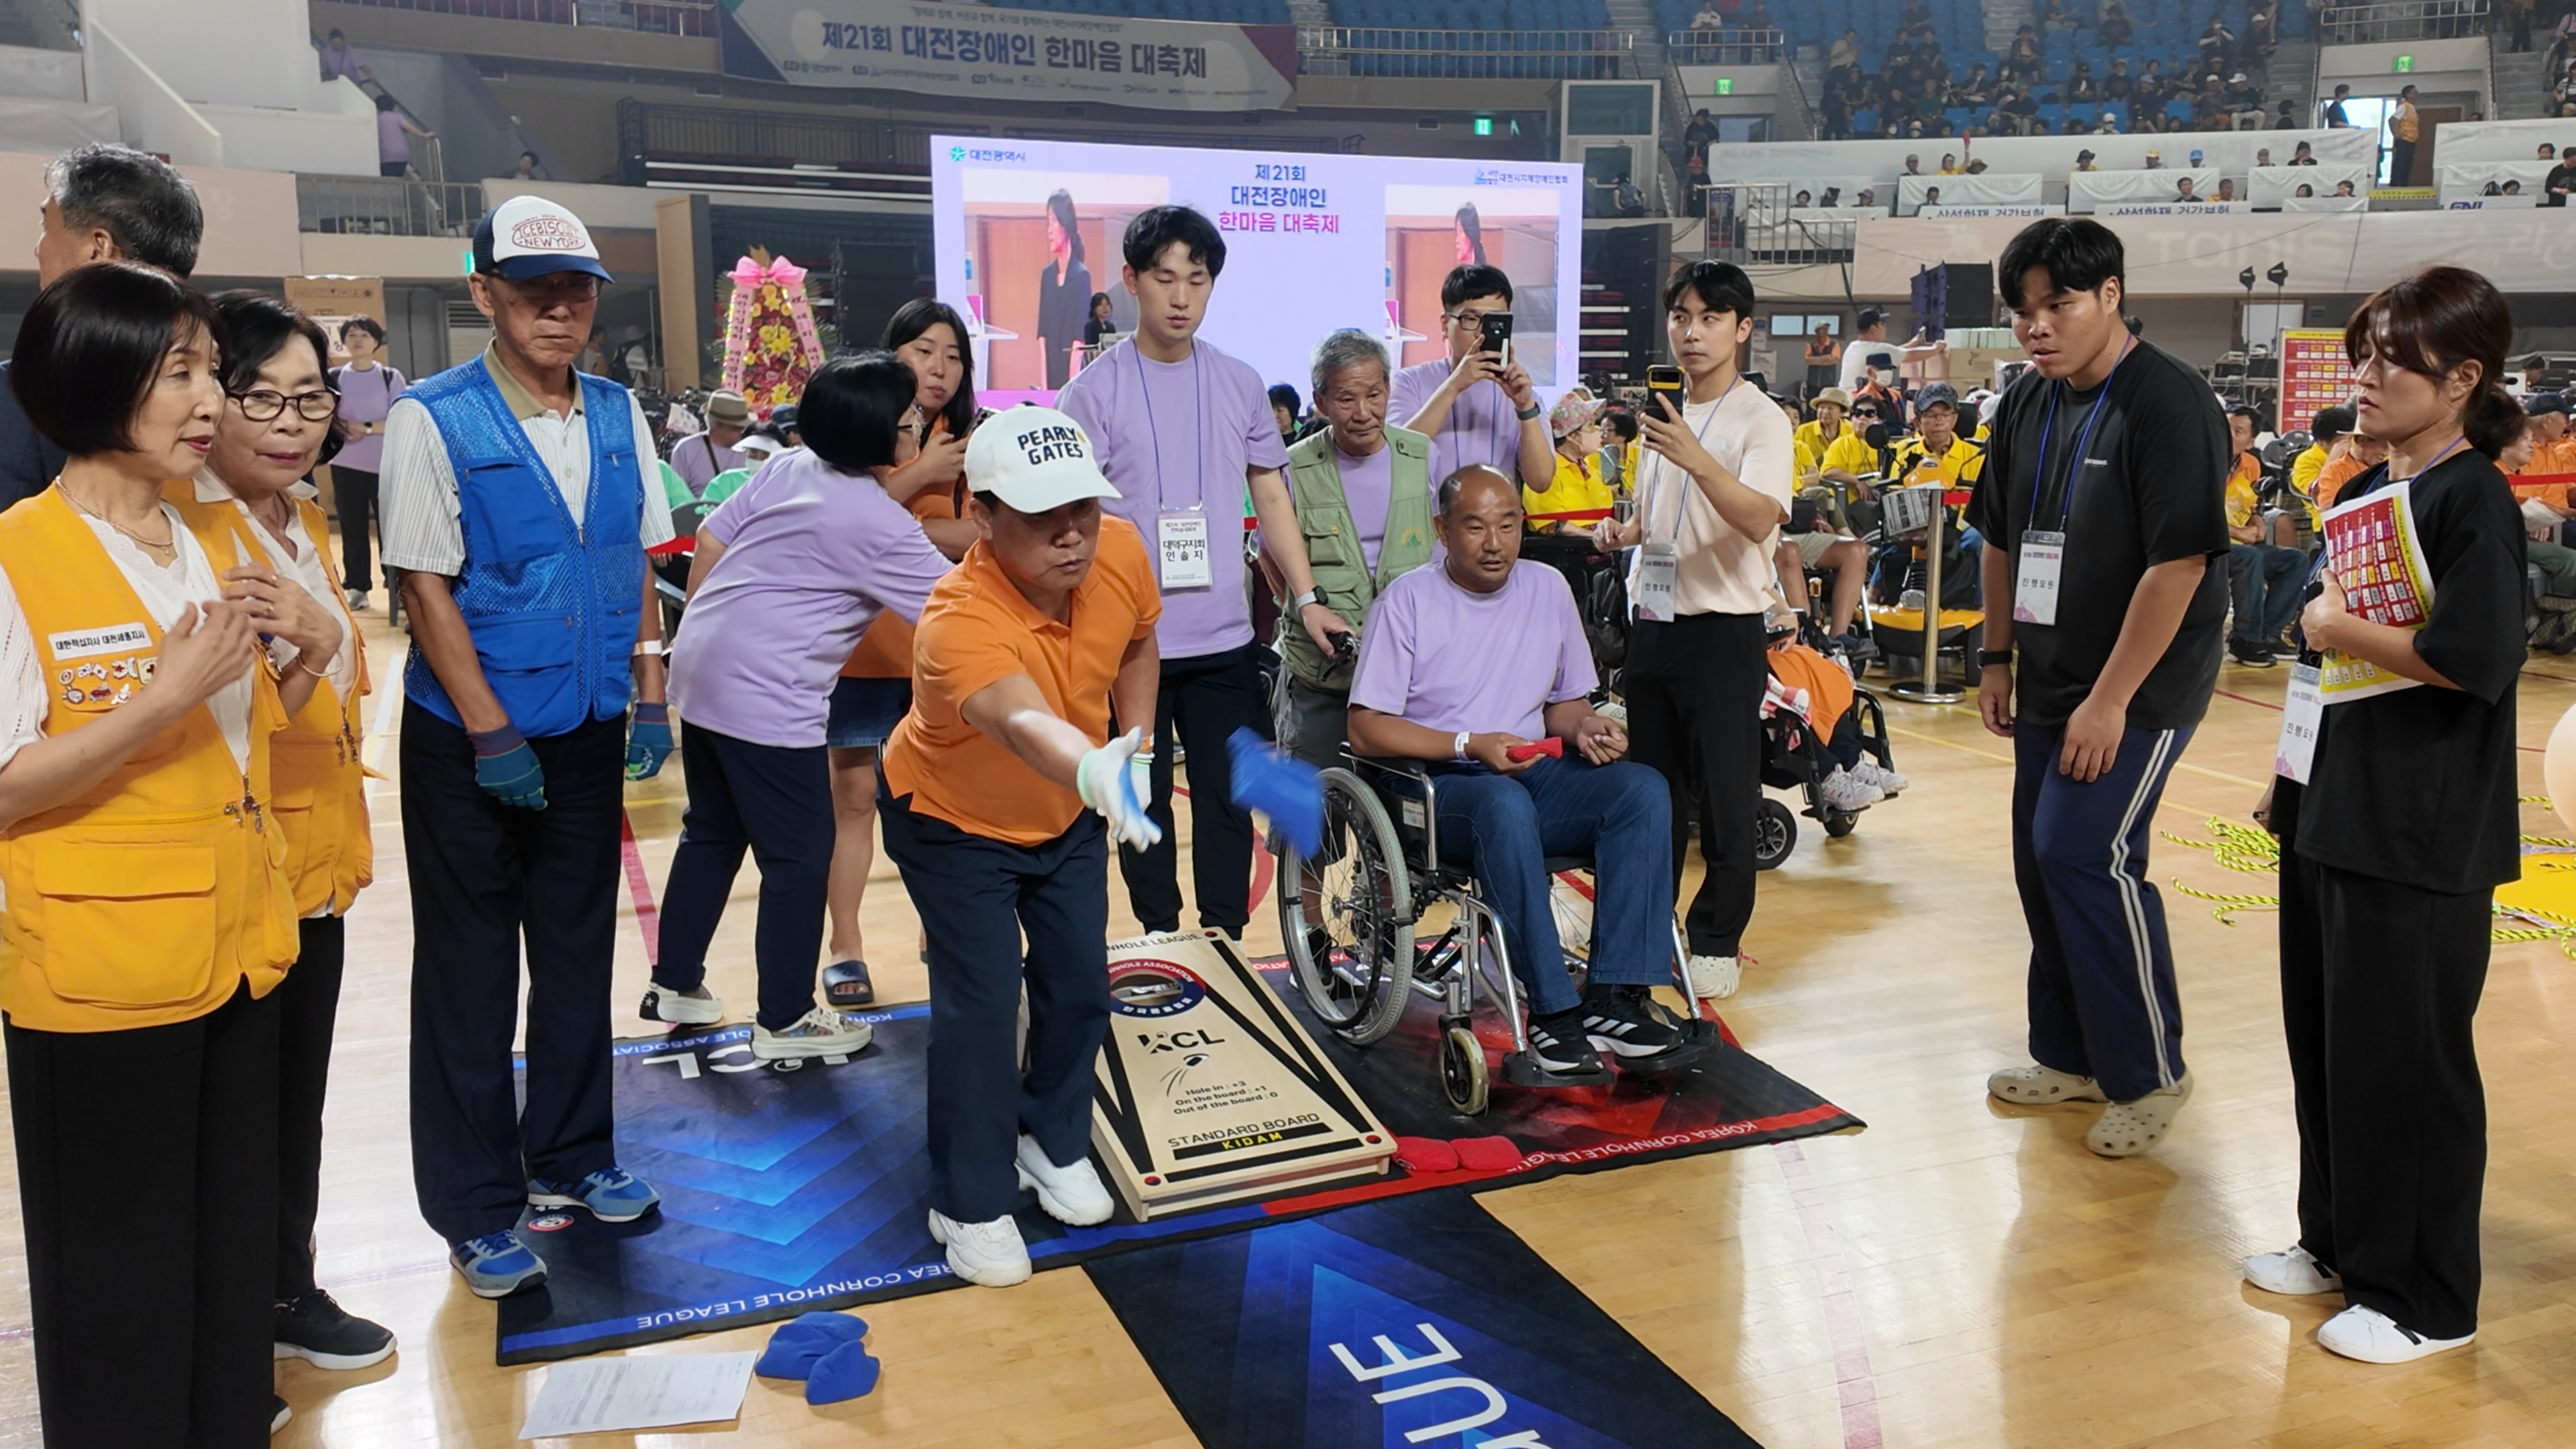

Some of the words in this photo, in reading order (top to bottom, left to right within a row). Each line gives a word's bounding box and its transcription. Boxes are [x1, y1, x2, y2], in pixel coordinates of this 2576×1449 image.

[822, 21, 893, 52] 제21회
[901, 25, 1036, 66] 대전장애인
[1044, 36, 1122, 73] 한마음
[1132, 42, 1206, 79] 대축제
[969, 148, 1026, 162] 대전광역시
[1254, 164, 1306, 182] 제21회
[1231, 186, 1327, 209] 대전장애인
[1218, 211, 1275, 232] 한마음
[1283, 213, 1340, 234] 대축제
[1017, 425, 1078, 451] PEARLY
[1028, 441, 1083, 466] GATES
[55, 636, 101, 650] 대한적십자사
[101, 630, 146, 645] 대전세종지사
[1107, 940, 1150, 952] NHOLE
[1150, 933, 1202, 946] LEAGUE
[1143, 961, 1195, 983] ASSOCIATION
[1136, 1029, 1226, 1055] KCL
[1185, 1087, 1212, 1096] Hole
[1212, 1084, 1224, 1092] in
[1232, 1080, 1246, 1088] +3
[1193, 1093, 1213, 1103] the
[1213, 1089, 1246, 1100] board
[1254, 1085, 1267, 1093] +1
[1173, 1106, 1195, 1115] Out
[1196, 1103, 1208, 1111] of
[1210, 1099, 1230, 1109] the
[1230, 1094, 1263, 1106] board
[1167, 1124, 1260, 1148] STANDARD
[1262, 1112, 1320, 1130] BOARD
[1222, 1131, 1283, 1150] KIDAM
[1690, 1121, 1758, 1140] KOREA
[1584, 1134, 1692, 1158] CORNHOLE
[754, 1273, 902, 1308] CORNHOLE
[637, 1299, 746, 1329] LEAGUE
